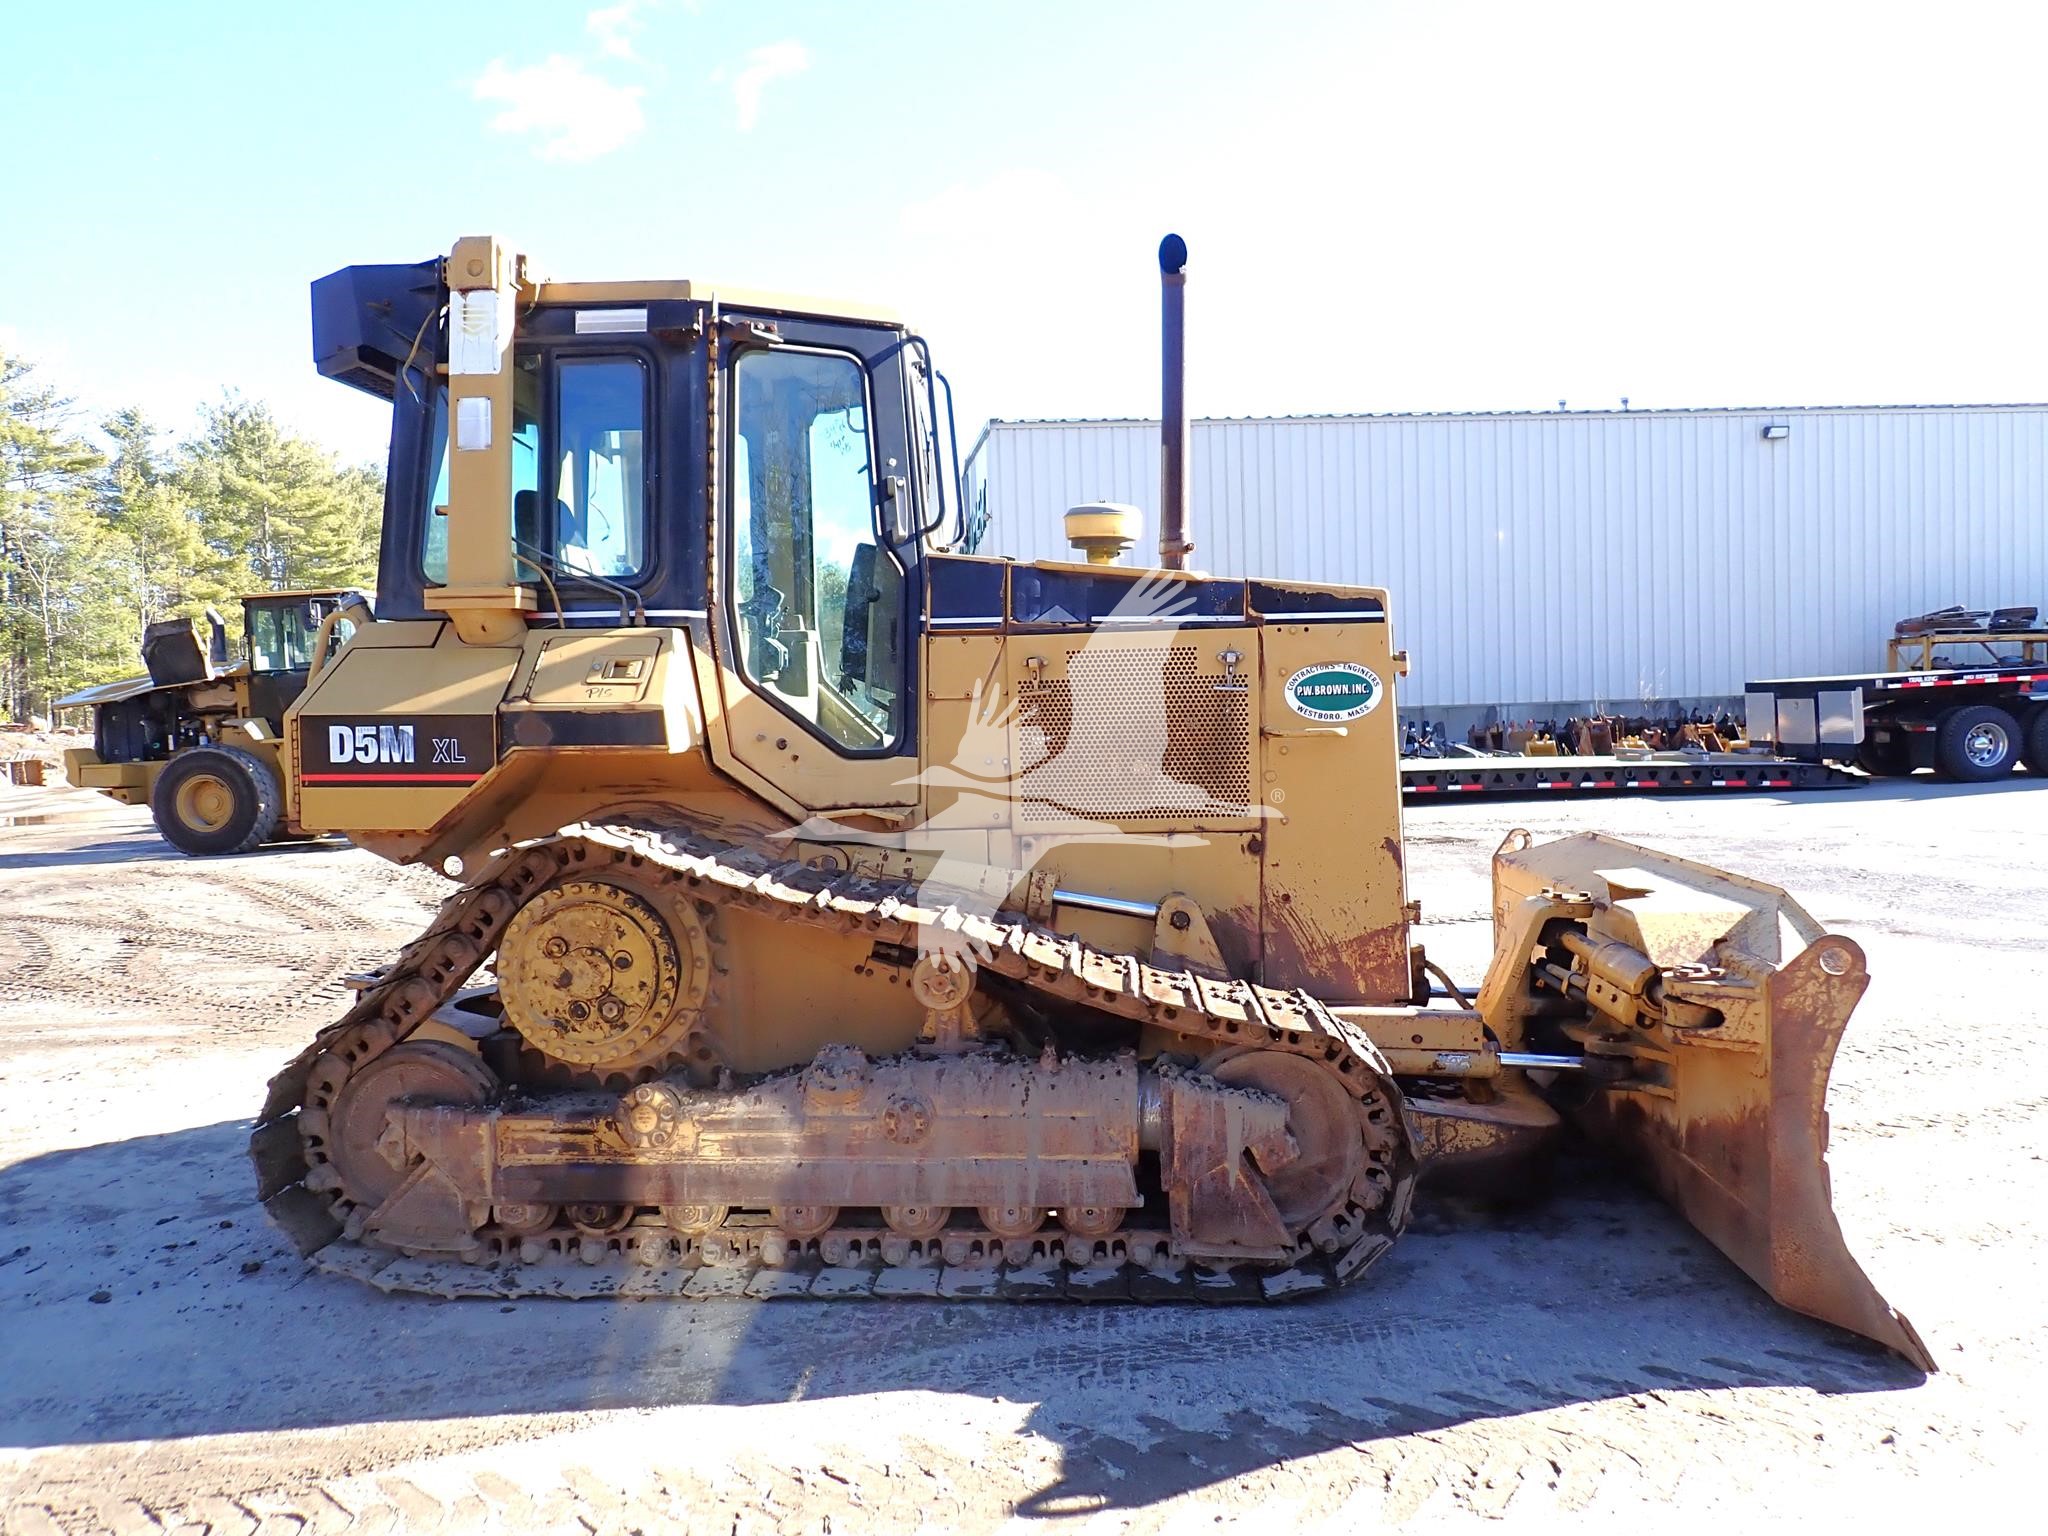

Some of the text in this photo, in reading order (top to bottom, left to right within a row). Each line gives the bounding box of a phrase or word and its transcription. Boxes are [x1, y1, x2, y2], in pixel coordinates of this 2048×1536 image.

[1343, 663, 1380, 688] ENGINEERS
[329, 725, 466, 764] D5M XL
